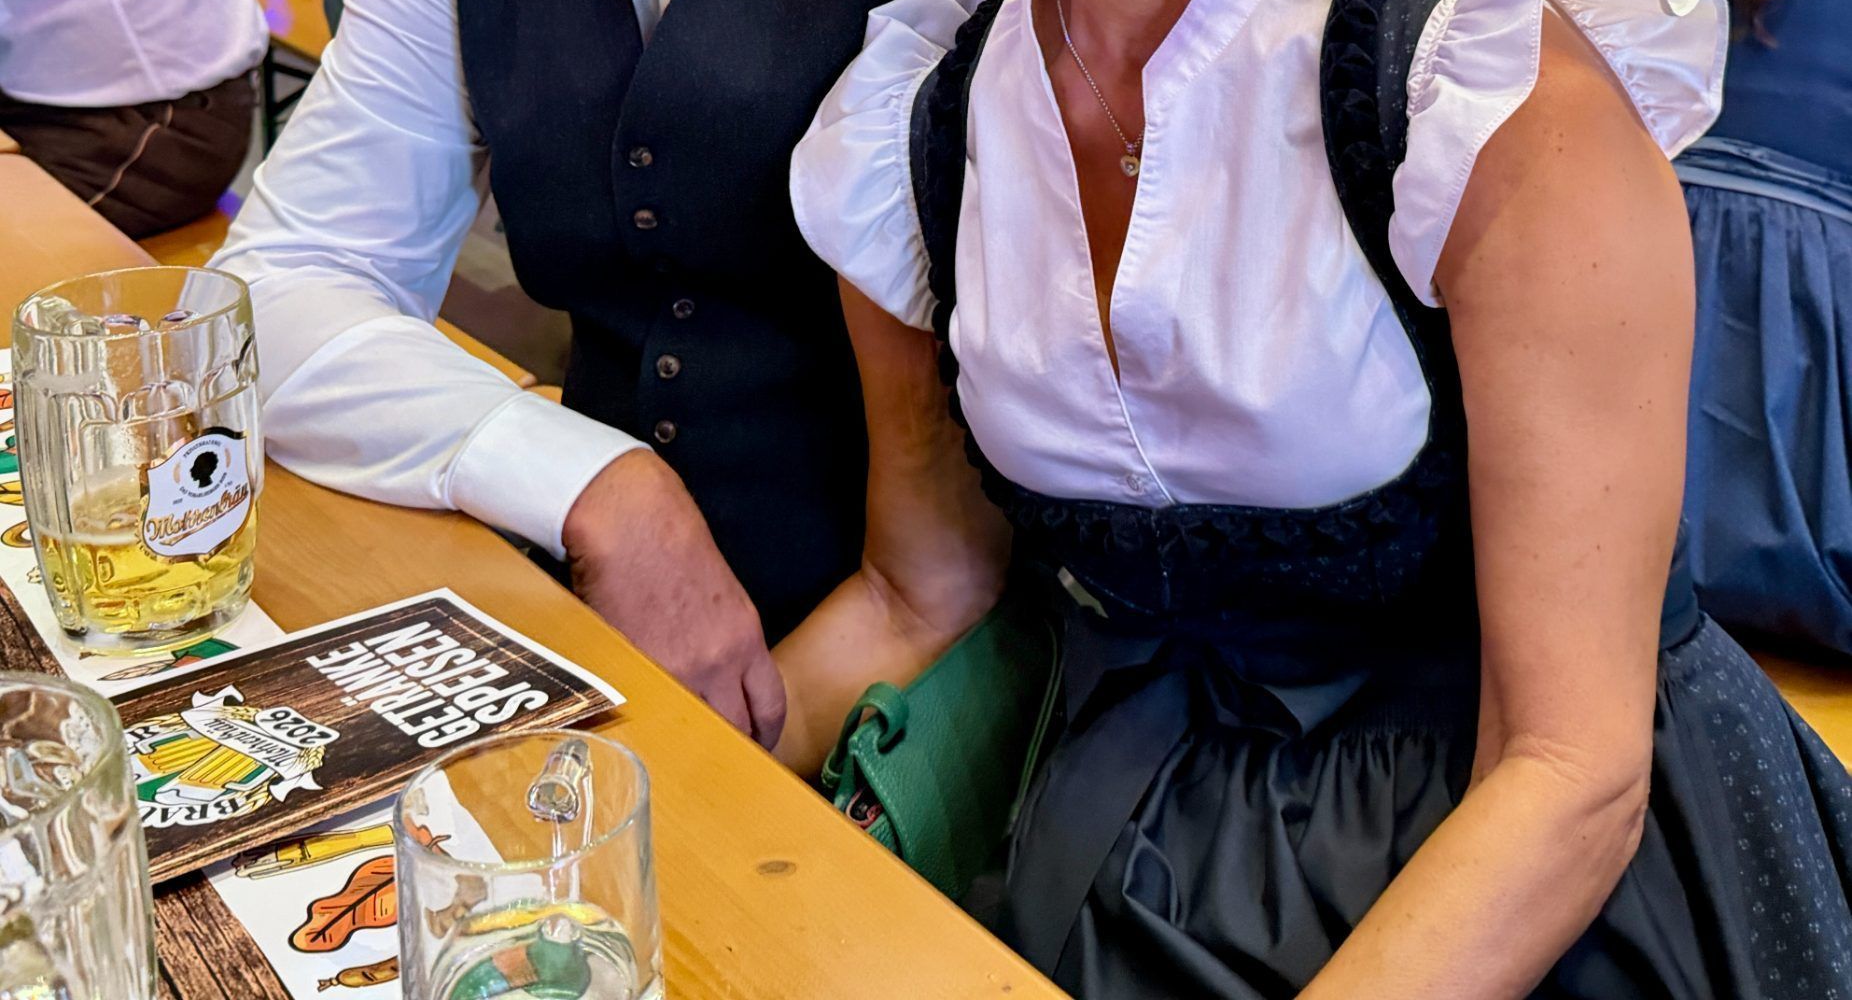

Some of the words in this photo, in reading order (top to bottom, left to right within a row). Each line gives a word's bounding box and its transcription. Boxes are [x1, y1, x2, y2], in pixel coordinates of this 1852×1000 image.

[306, 641, 480, 748] GETRÄNKE
[364, 621, 549, 724] SPEISEN
[203, 718, 298, 768] Mohrenbräu
[262, 709, 333, 747] 2026
